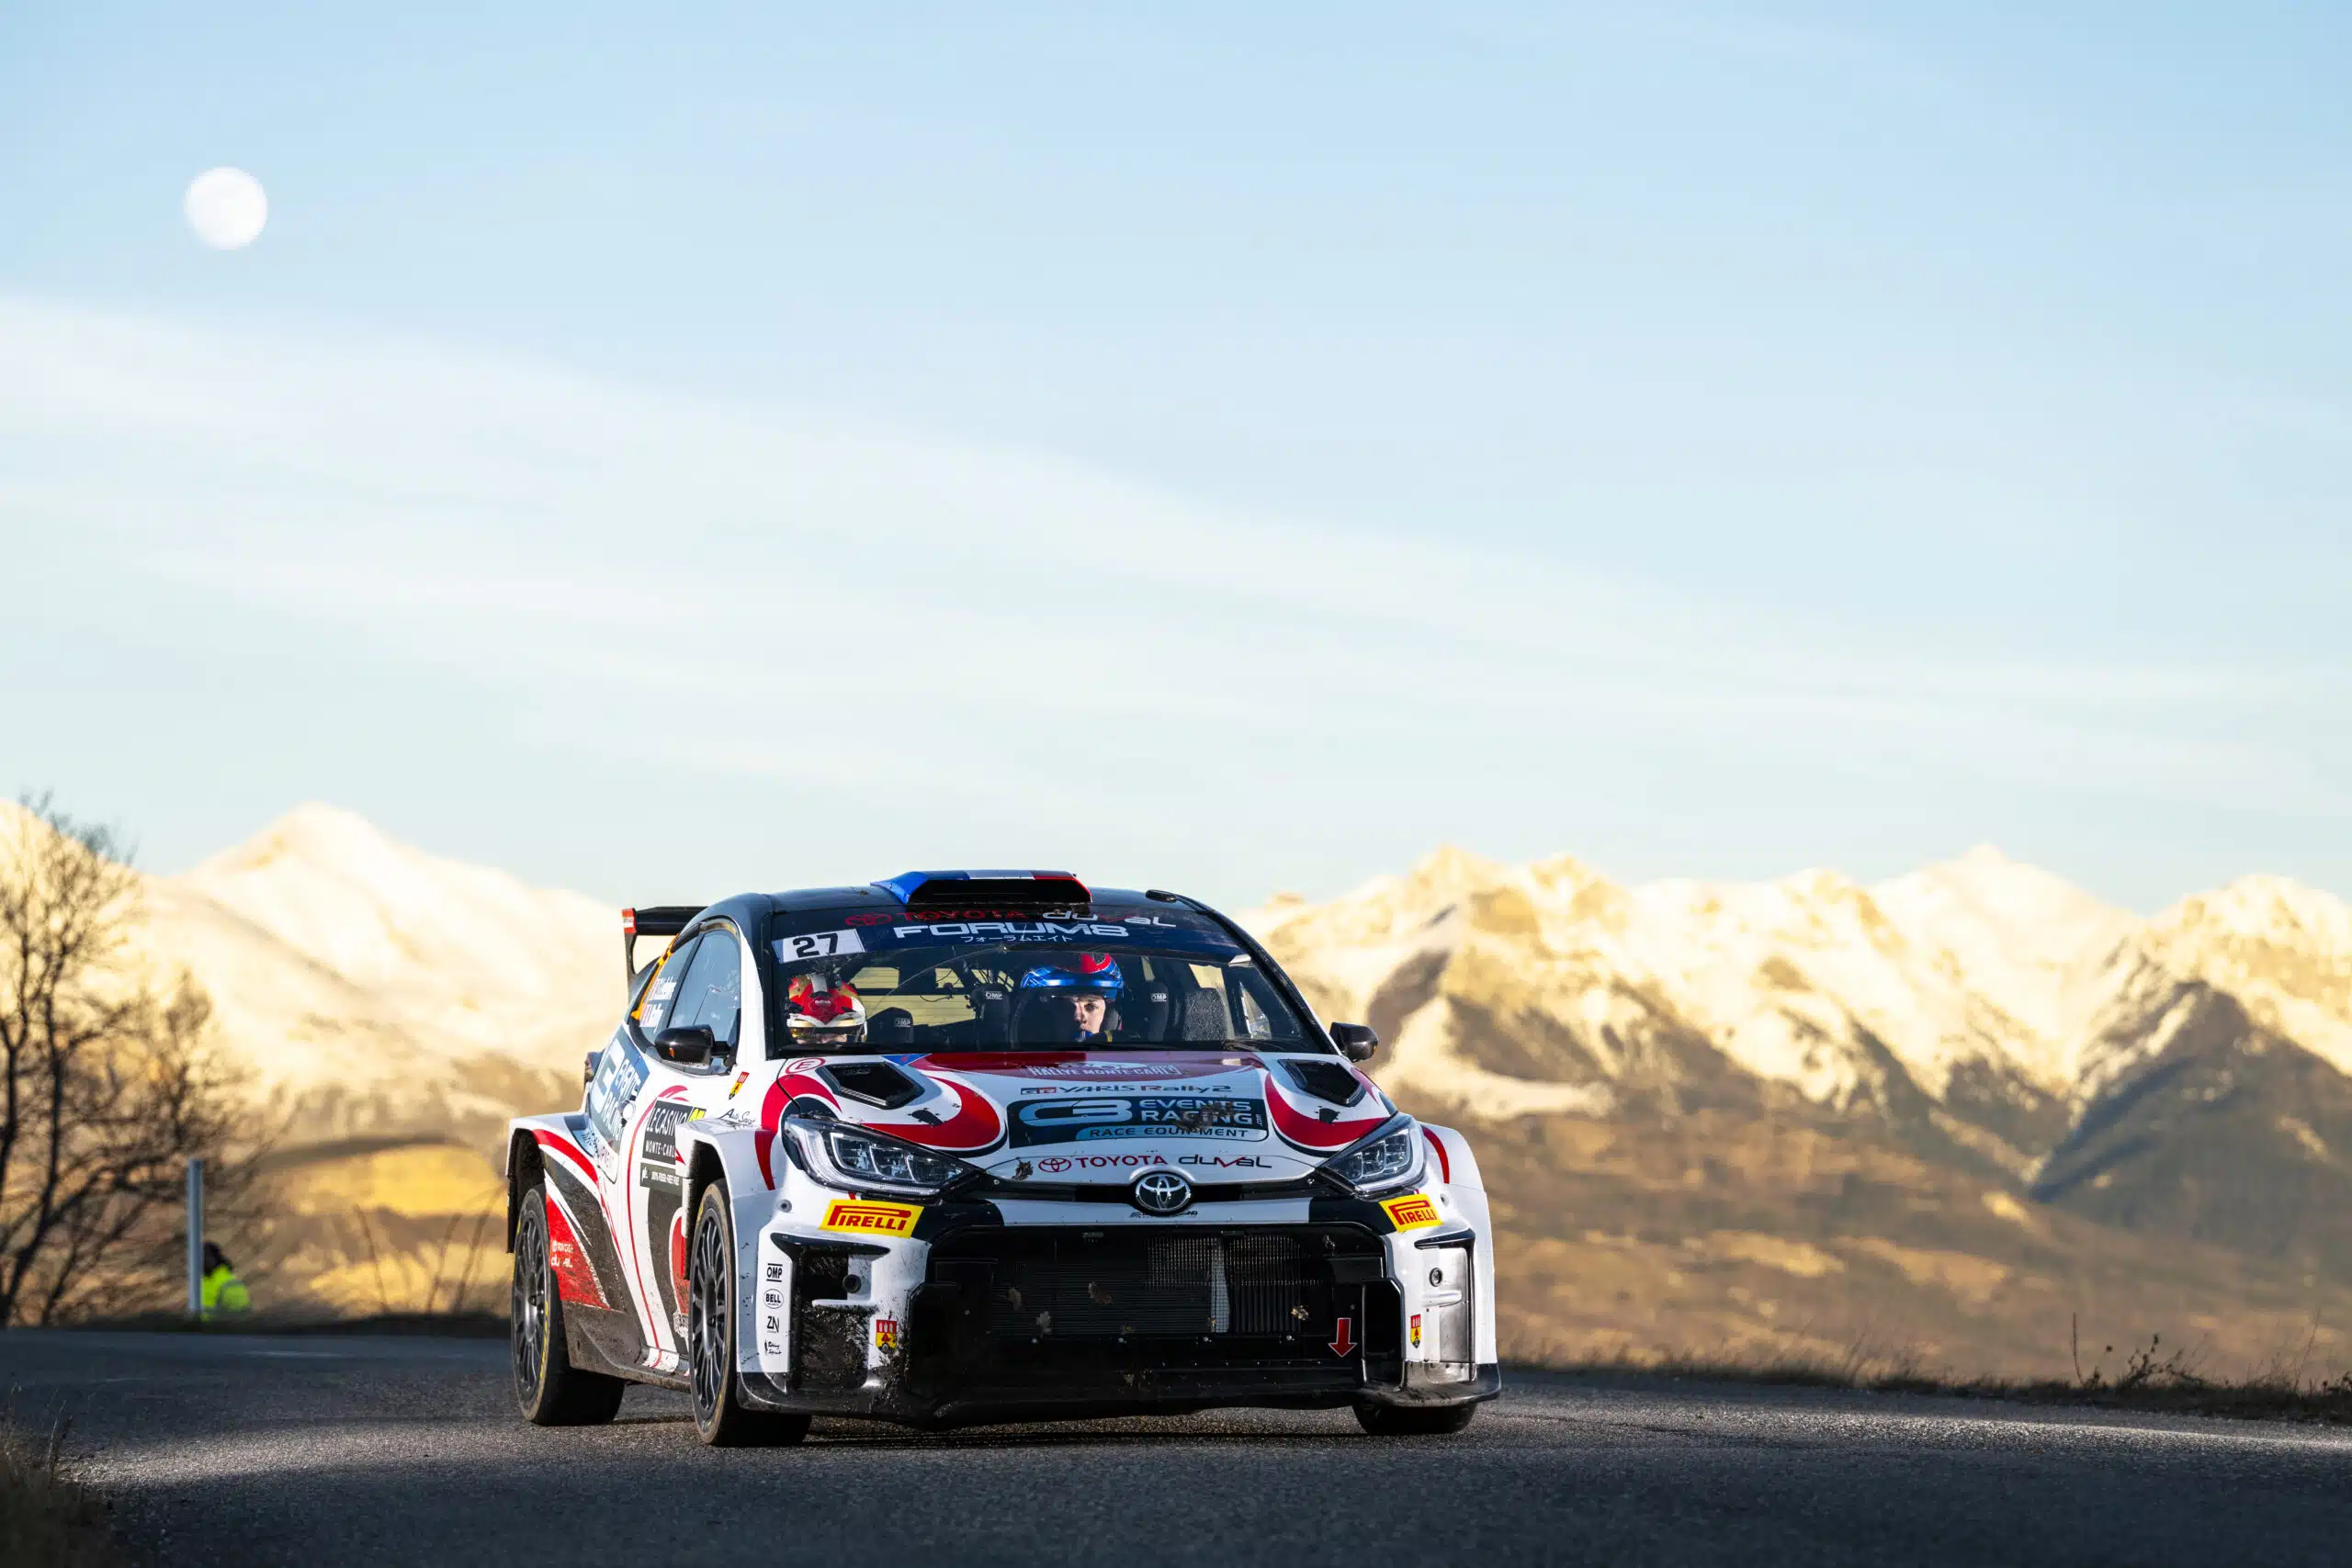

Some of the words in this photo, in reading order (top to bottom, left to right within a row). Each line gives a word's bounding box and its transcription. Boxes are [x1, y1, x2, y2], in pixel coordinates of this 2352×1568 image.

[896, 910, 1030, 923] TOYOTA
[893, 922, 1129, 939] FORUM8
[792, 932, 838, 958] 27
[960, 935, 1073, 943] フォーラムエイト
[1150, 992, 1168, 1002] OMP
[1059, 1085, 1136, 1093] YARIS
[1140, 1085, 1233, 1094] Rally2
[1139, 1100, 1252, 1112] EVENTS
[1141, 1110, 1253, 1125] RACING
[1090, 1127, 1136, 1138] RACE
[1144, 1127, 1250, 1138] EQUIMENT
[1075, 1155, 1169, 1168] TOYOTA
[827, 1204, 912, 1232] PIRELLI
[1388, 1199, 1437, 1226] PIRELLI
[766, 1265, 783, 1280] OMP
[765, 1292, 781, 1304] BELL
